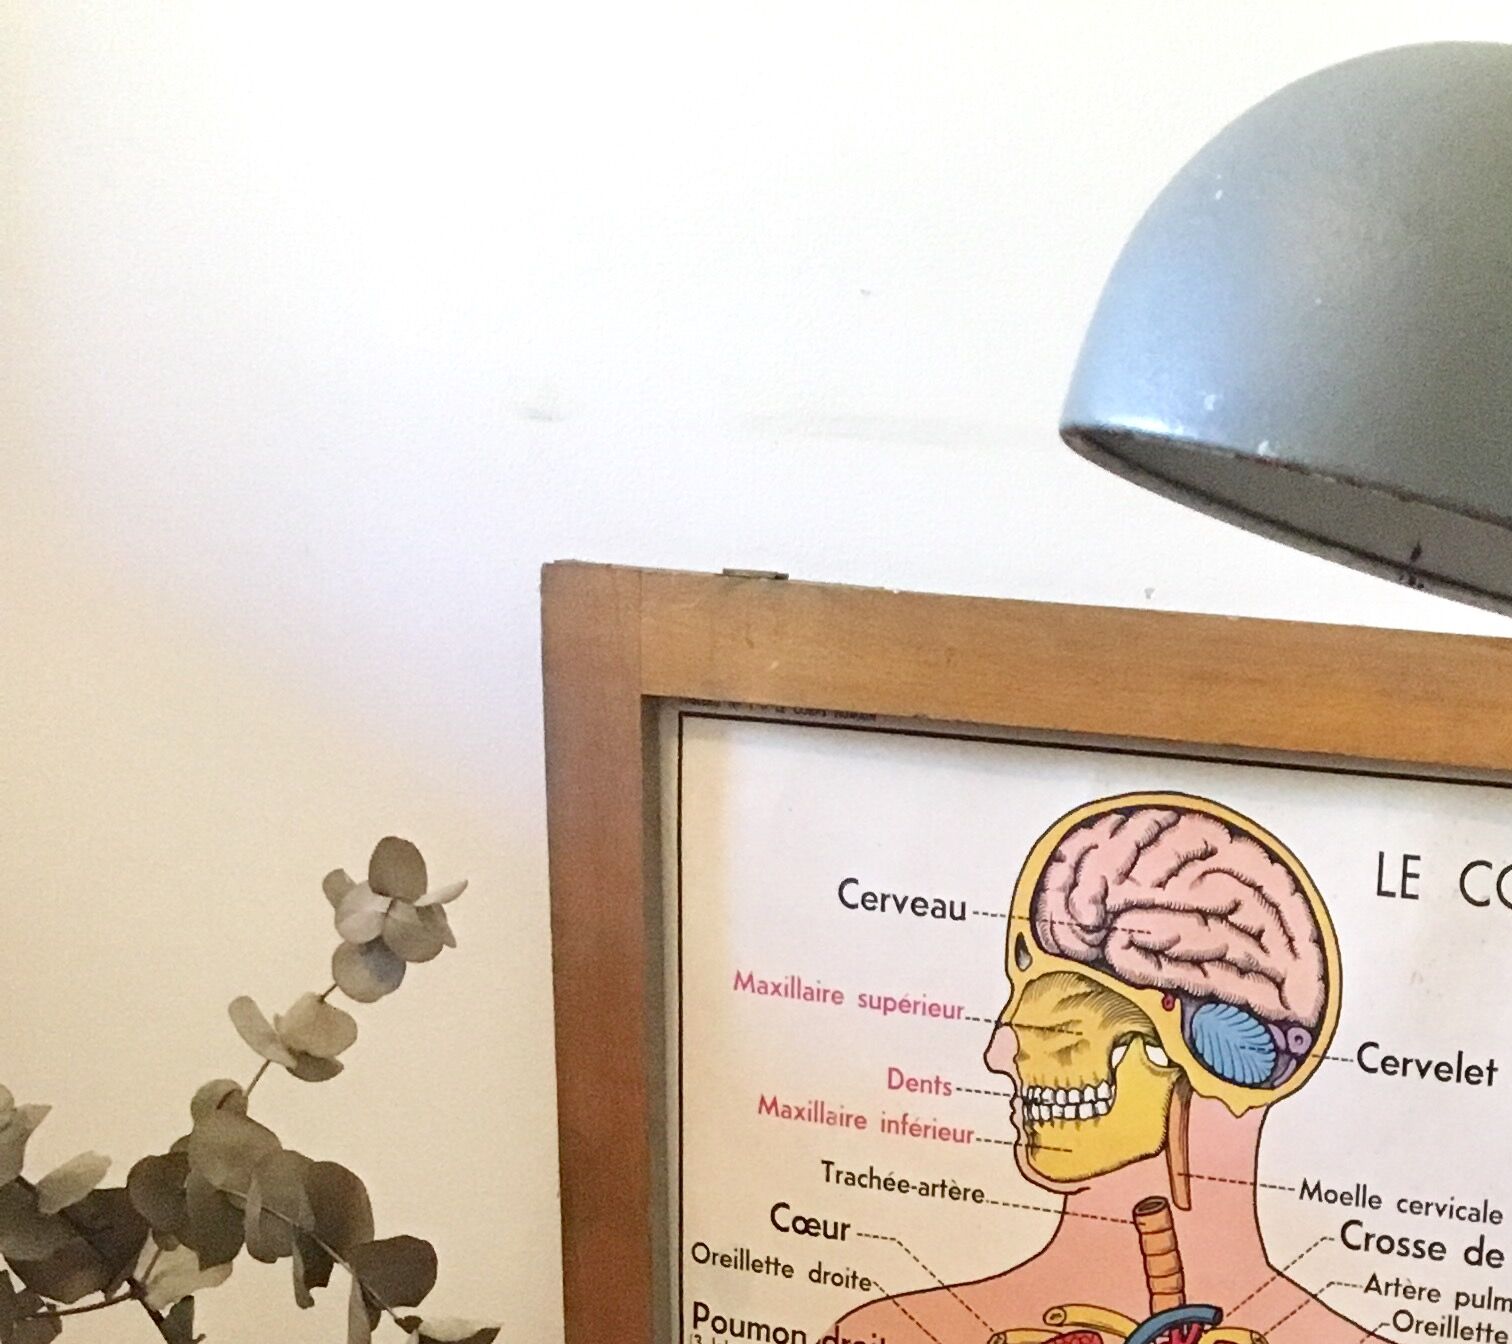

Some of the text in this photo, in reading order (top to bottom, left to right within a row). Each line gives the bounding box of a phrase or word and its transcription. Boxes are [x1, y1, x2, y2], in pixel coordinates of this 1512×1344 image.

[1375, 850, 1422, 900] LE
[837, 877, 968, 922] Cerveau
[732, 969, 966, 1022] Maxillaire supérieur
[886, 1067, 953, 1097] Dents
[1355, 1040, 1500, 1088] Cervelet
[756, 1094, 975, 1144] Maxillaire inférieur
[820, 1159, 985, 1204] Trachée-artère
[1298, 1178, 1504, 1226] Moelle cervicale
[769, 1201, 852, 1243] Cœur
[1339, 1220, 1448, 1263] Crosse
[1463, 1233, 1506, 1269] de
[690, 1241, 873, 1293] Oreillette droite
[1362, 1273, 1442, 1305] Artère
